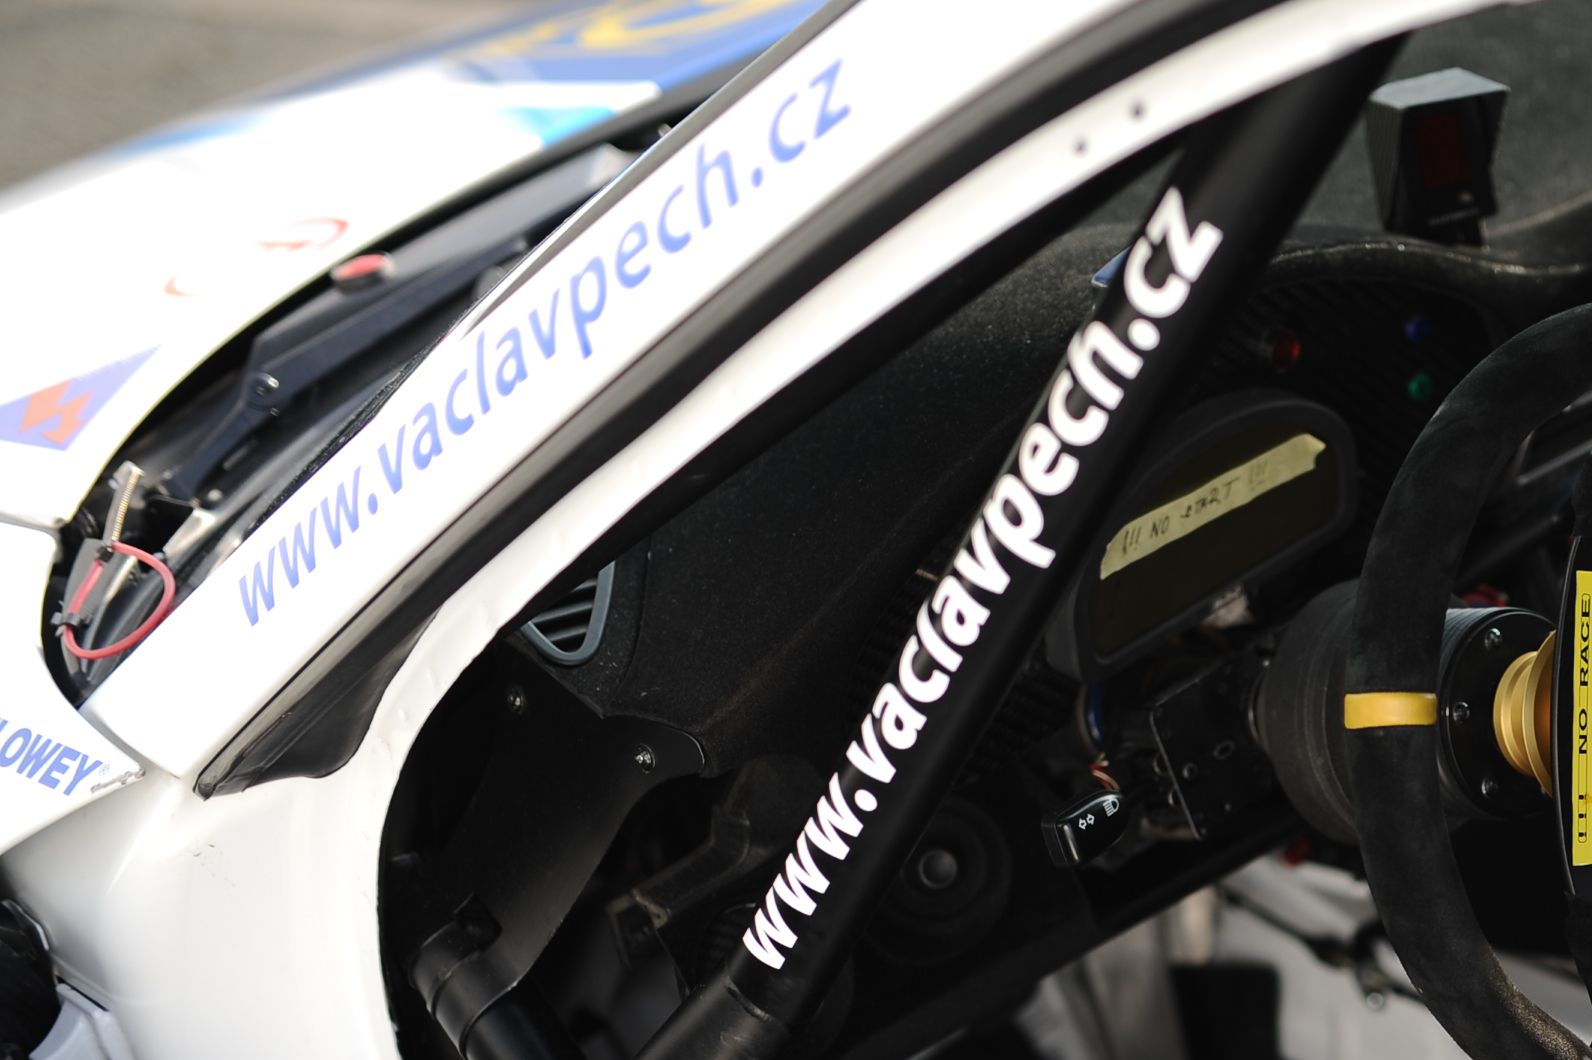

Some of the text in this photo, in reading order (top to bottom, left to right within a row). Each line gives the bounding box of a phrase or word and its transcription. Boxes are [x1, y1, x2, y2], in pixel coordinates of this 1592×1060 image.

[238, 58, 852, 628] www.vaclavpech.cz
[1149, 515, 1171, 540] NO
[742, 185, 1224, 971] www.vaclavpech.cz
[1578, 594, 1592, 687] RACE
[1578, 707, 1589, 755] NO
